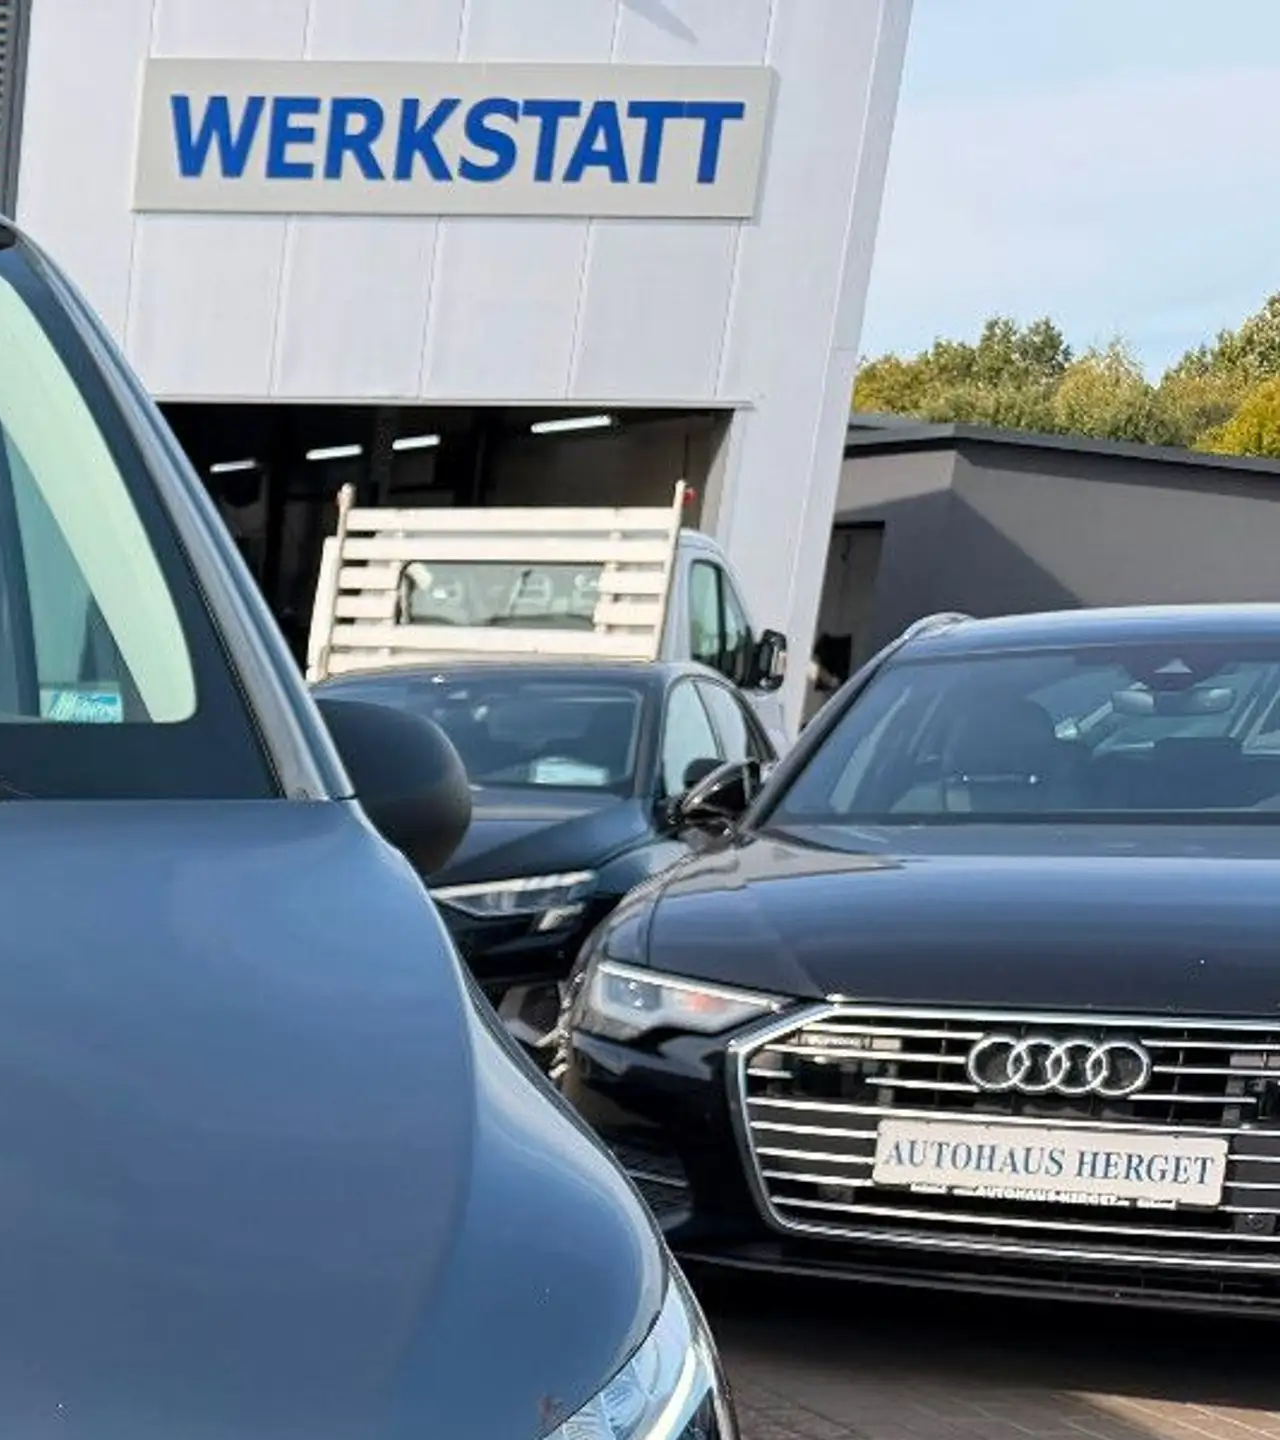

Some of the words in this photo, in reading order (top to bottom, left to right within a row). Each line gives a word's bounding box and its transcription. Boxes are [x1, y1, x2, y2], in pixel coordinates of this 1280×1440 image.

[170, 95, 746, 185] WERKSTATT
[885, 1139, 1066, 1177] AUTOHAUS
[1075, 1151, 1215, 1185] HERGET
